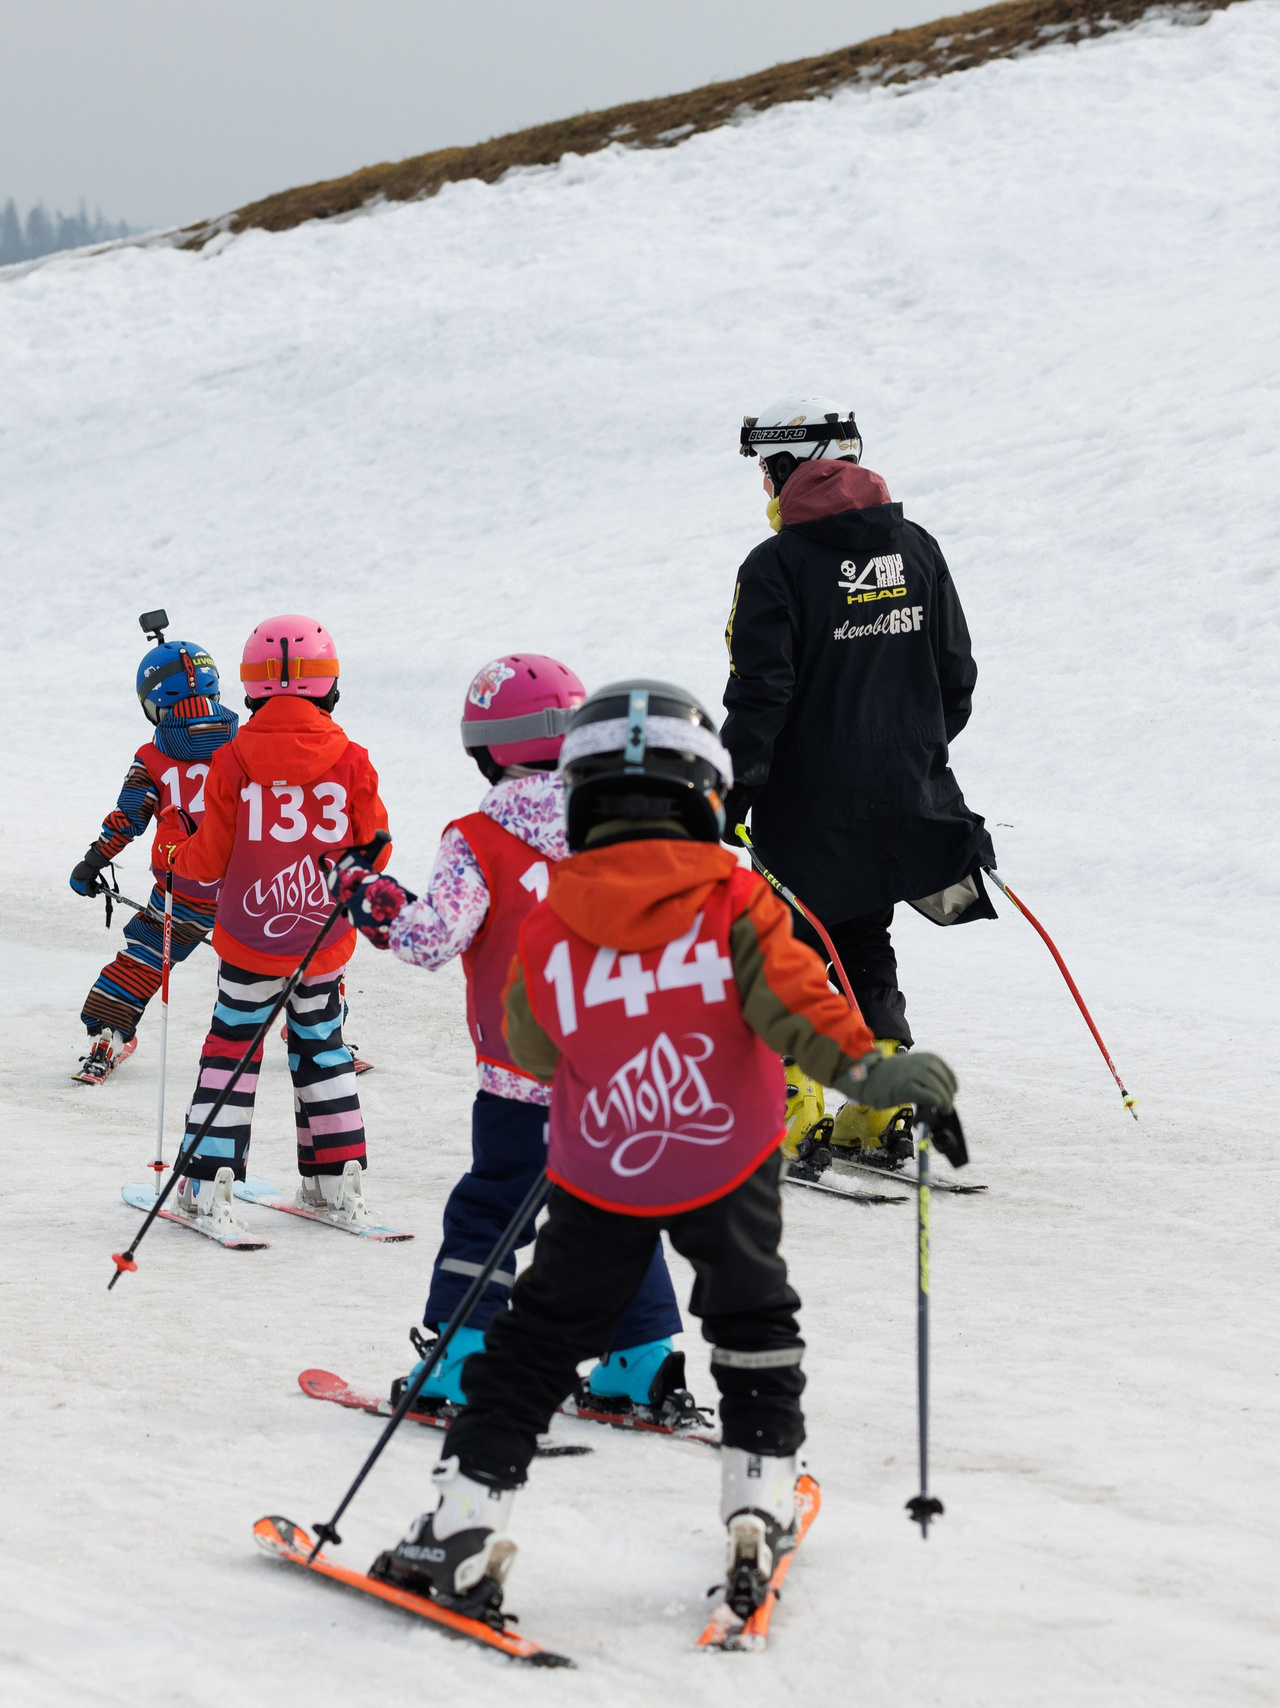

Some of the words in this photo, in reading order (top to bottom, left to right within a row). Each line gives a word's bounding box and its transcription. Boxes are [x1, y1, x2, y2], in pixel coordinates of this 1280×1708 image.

[875, 562, 904, 580] CUP
[876, 575, 906, 588] REBELS
[847, 587, 907, 605] HEAD
[833, 605, 924, 641] #lenoblGSF
[240, 781, 349, 843] 133
[763, 869, 782, 890] LEKI
[543, 911, 734, 1037] 144
[397, 1544, 446, 1563] HEAD
